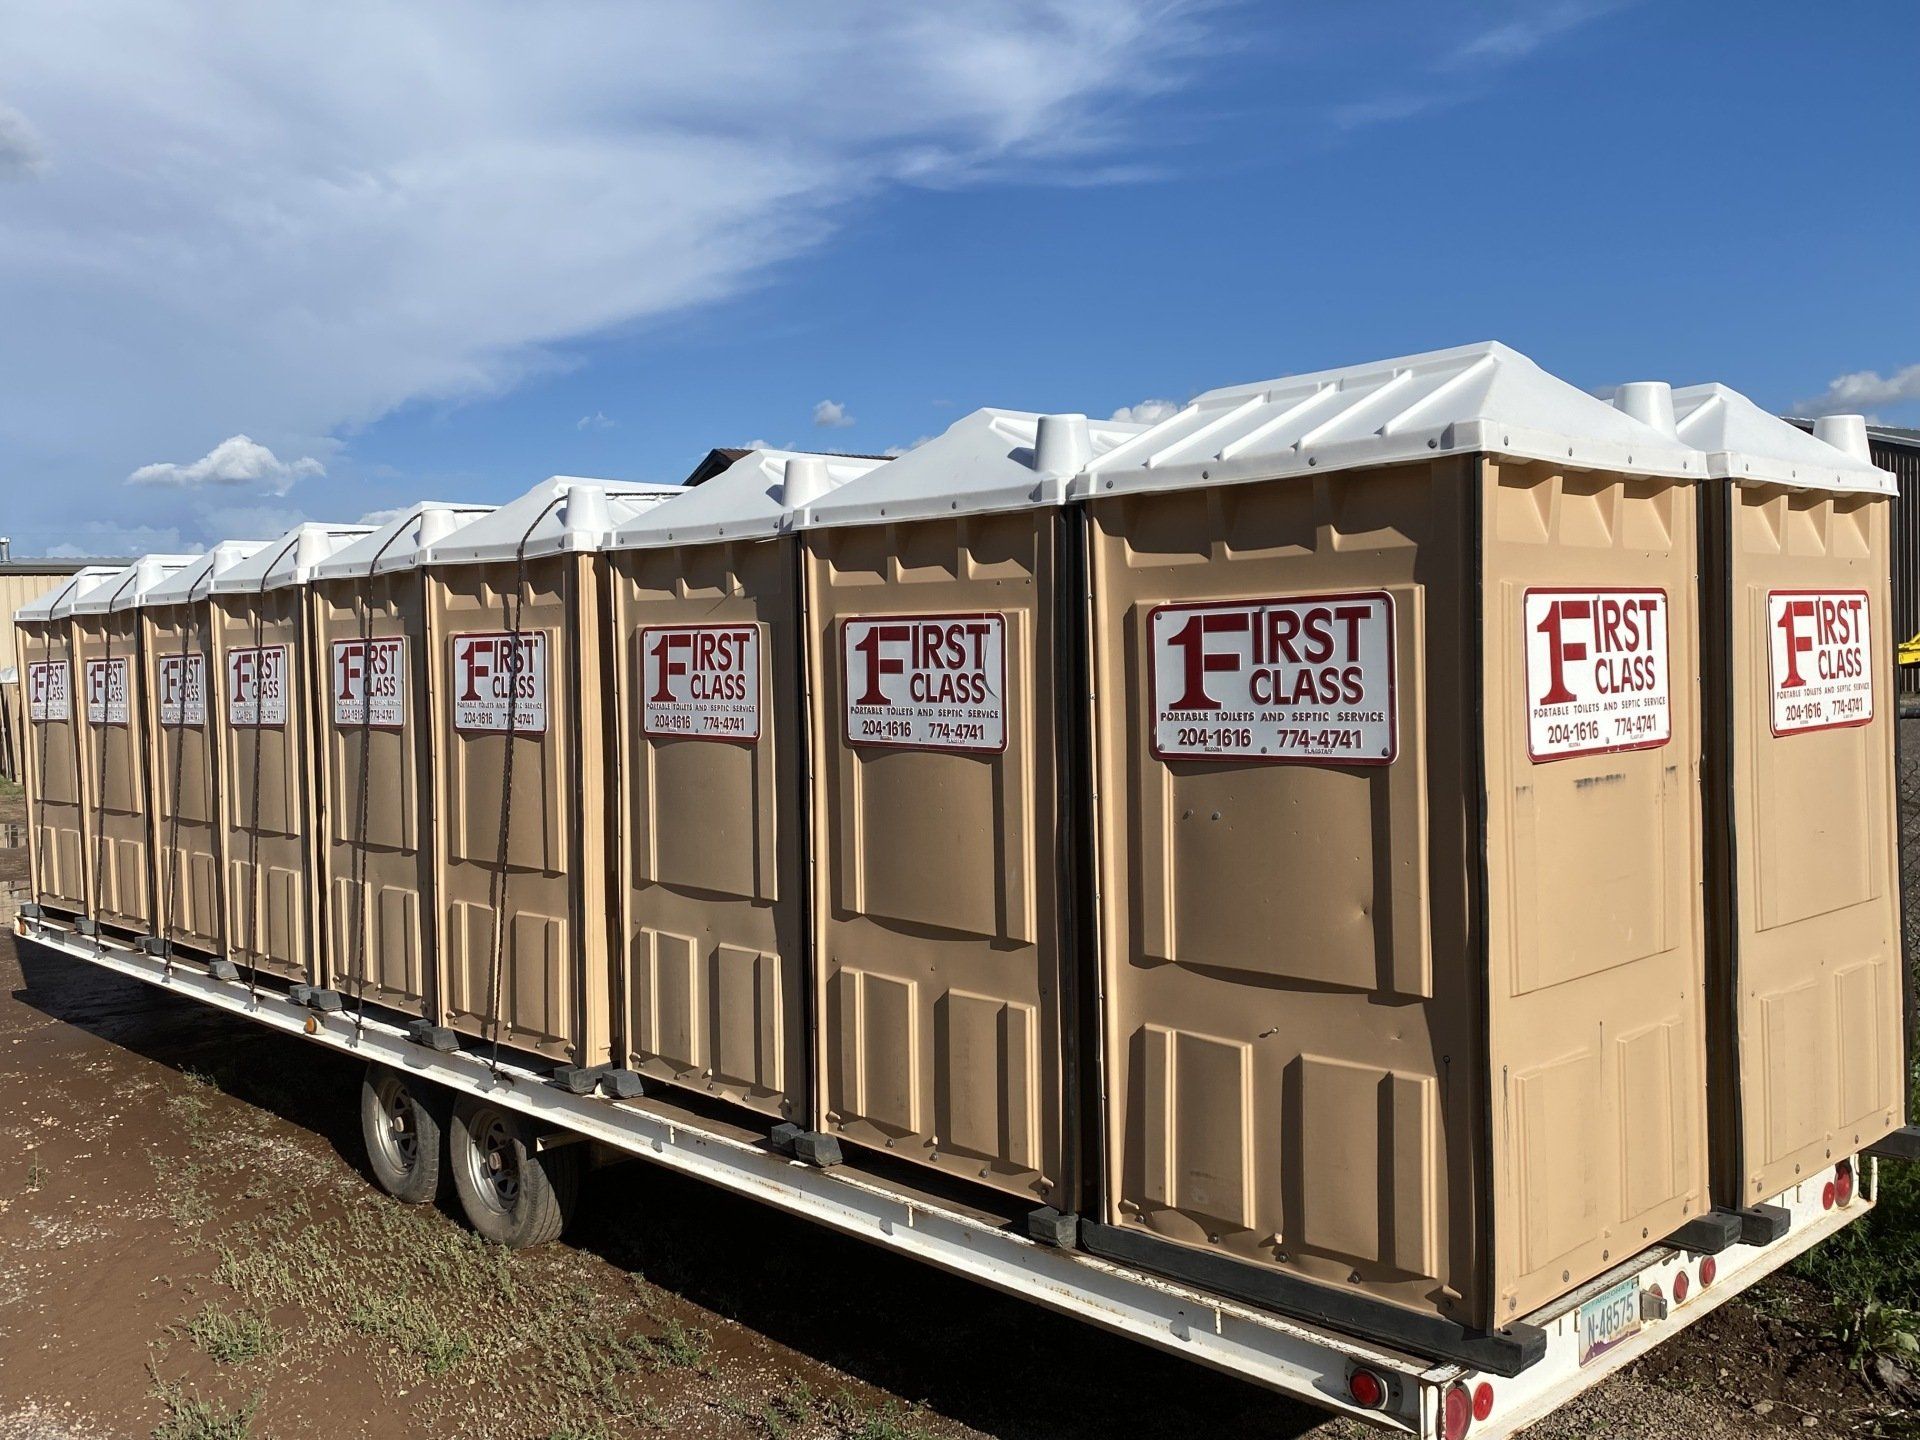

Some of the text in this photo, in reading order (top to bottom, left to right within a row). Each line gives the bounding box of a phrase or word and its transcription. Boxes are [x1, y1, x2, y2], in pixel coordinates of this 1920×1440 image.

[1595, 655, 1656, 695] CLASS
[1818, 647, 1862, 680] CLASS
[690, 674, 746, 700] CLASS
[910, 673, 986, 704] CLASS
[1250, 667, 1364, 705] CLASS
[1777, 689, 1801, 700] PORTABLE
[850, 707, 999, 719] PORTABLE TOILETS AND SEPTIC SERVICE
[1160, 712, 1384, 722] PORTABLE TOILETS AND SEPTIC SERVICE
[1534, 696, 1666, 718] PORTABLE TOILETS AND SEPTIC SERVICE
[1785, 697, 1863, 721] 204-1616 774-4741
[655, 715, 745, 731] 204-1616 774-4741
[862, 720, 984, 740] 204-1616 774-4741
[1548, 714, 1657, 744] 204-1616 774-4741
[1178, 728, 1362, 748] 204-1616 774-4741
